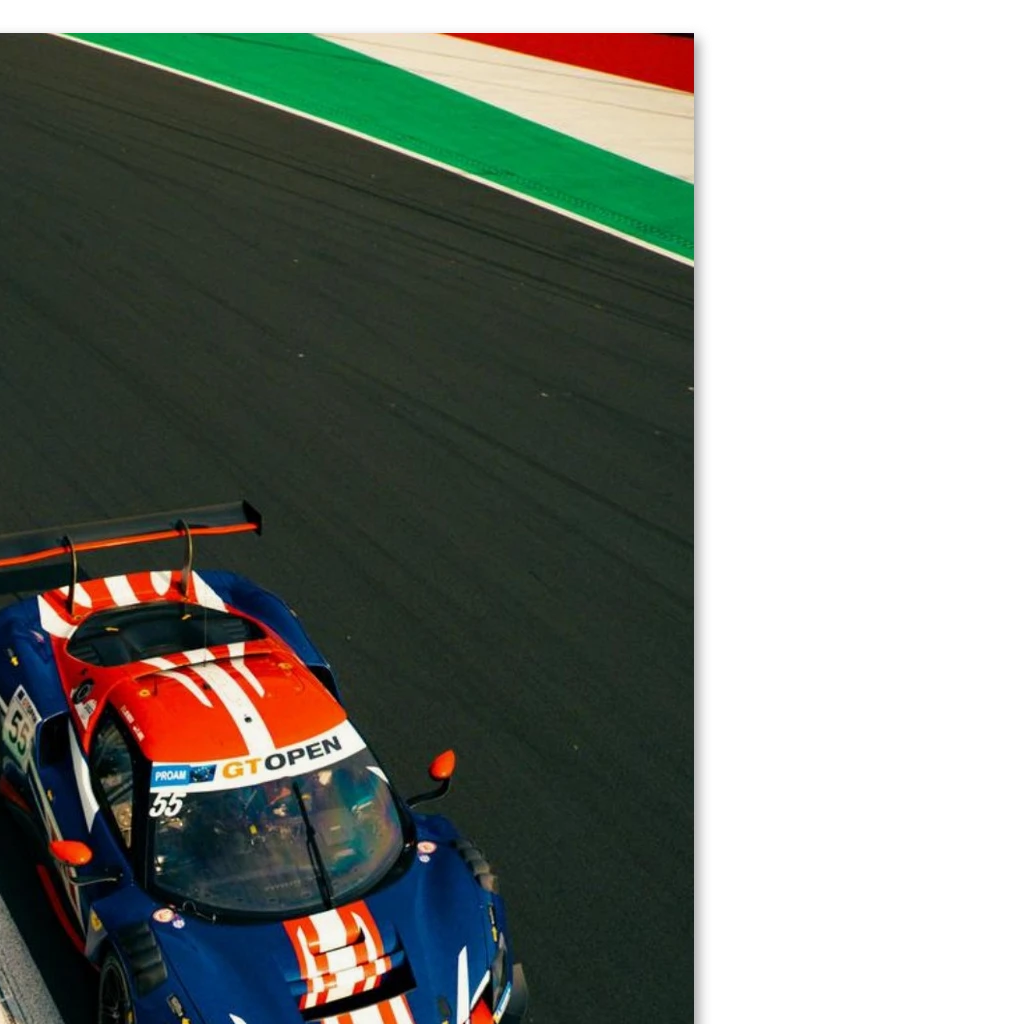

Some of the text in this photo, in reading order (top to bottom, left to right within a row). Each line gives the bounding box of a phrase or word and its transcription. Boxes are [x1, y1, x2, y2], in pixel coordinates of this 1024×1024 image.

[8, 710, 30, 756] 55
[155, 769, 187, 782] PROAM
[149, 793, 187, 817] 55
